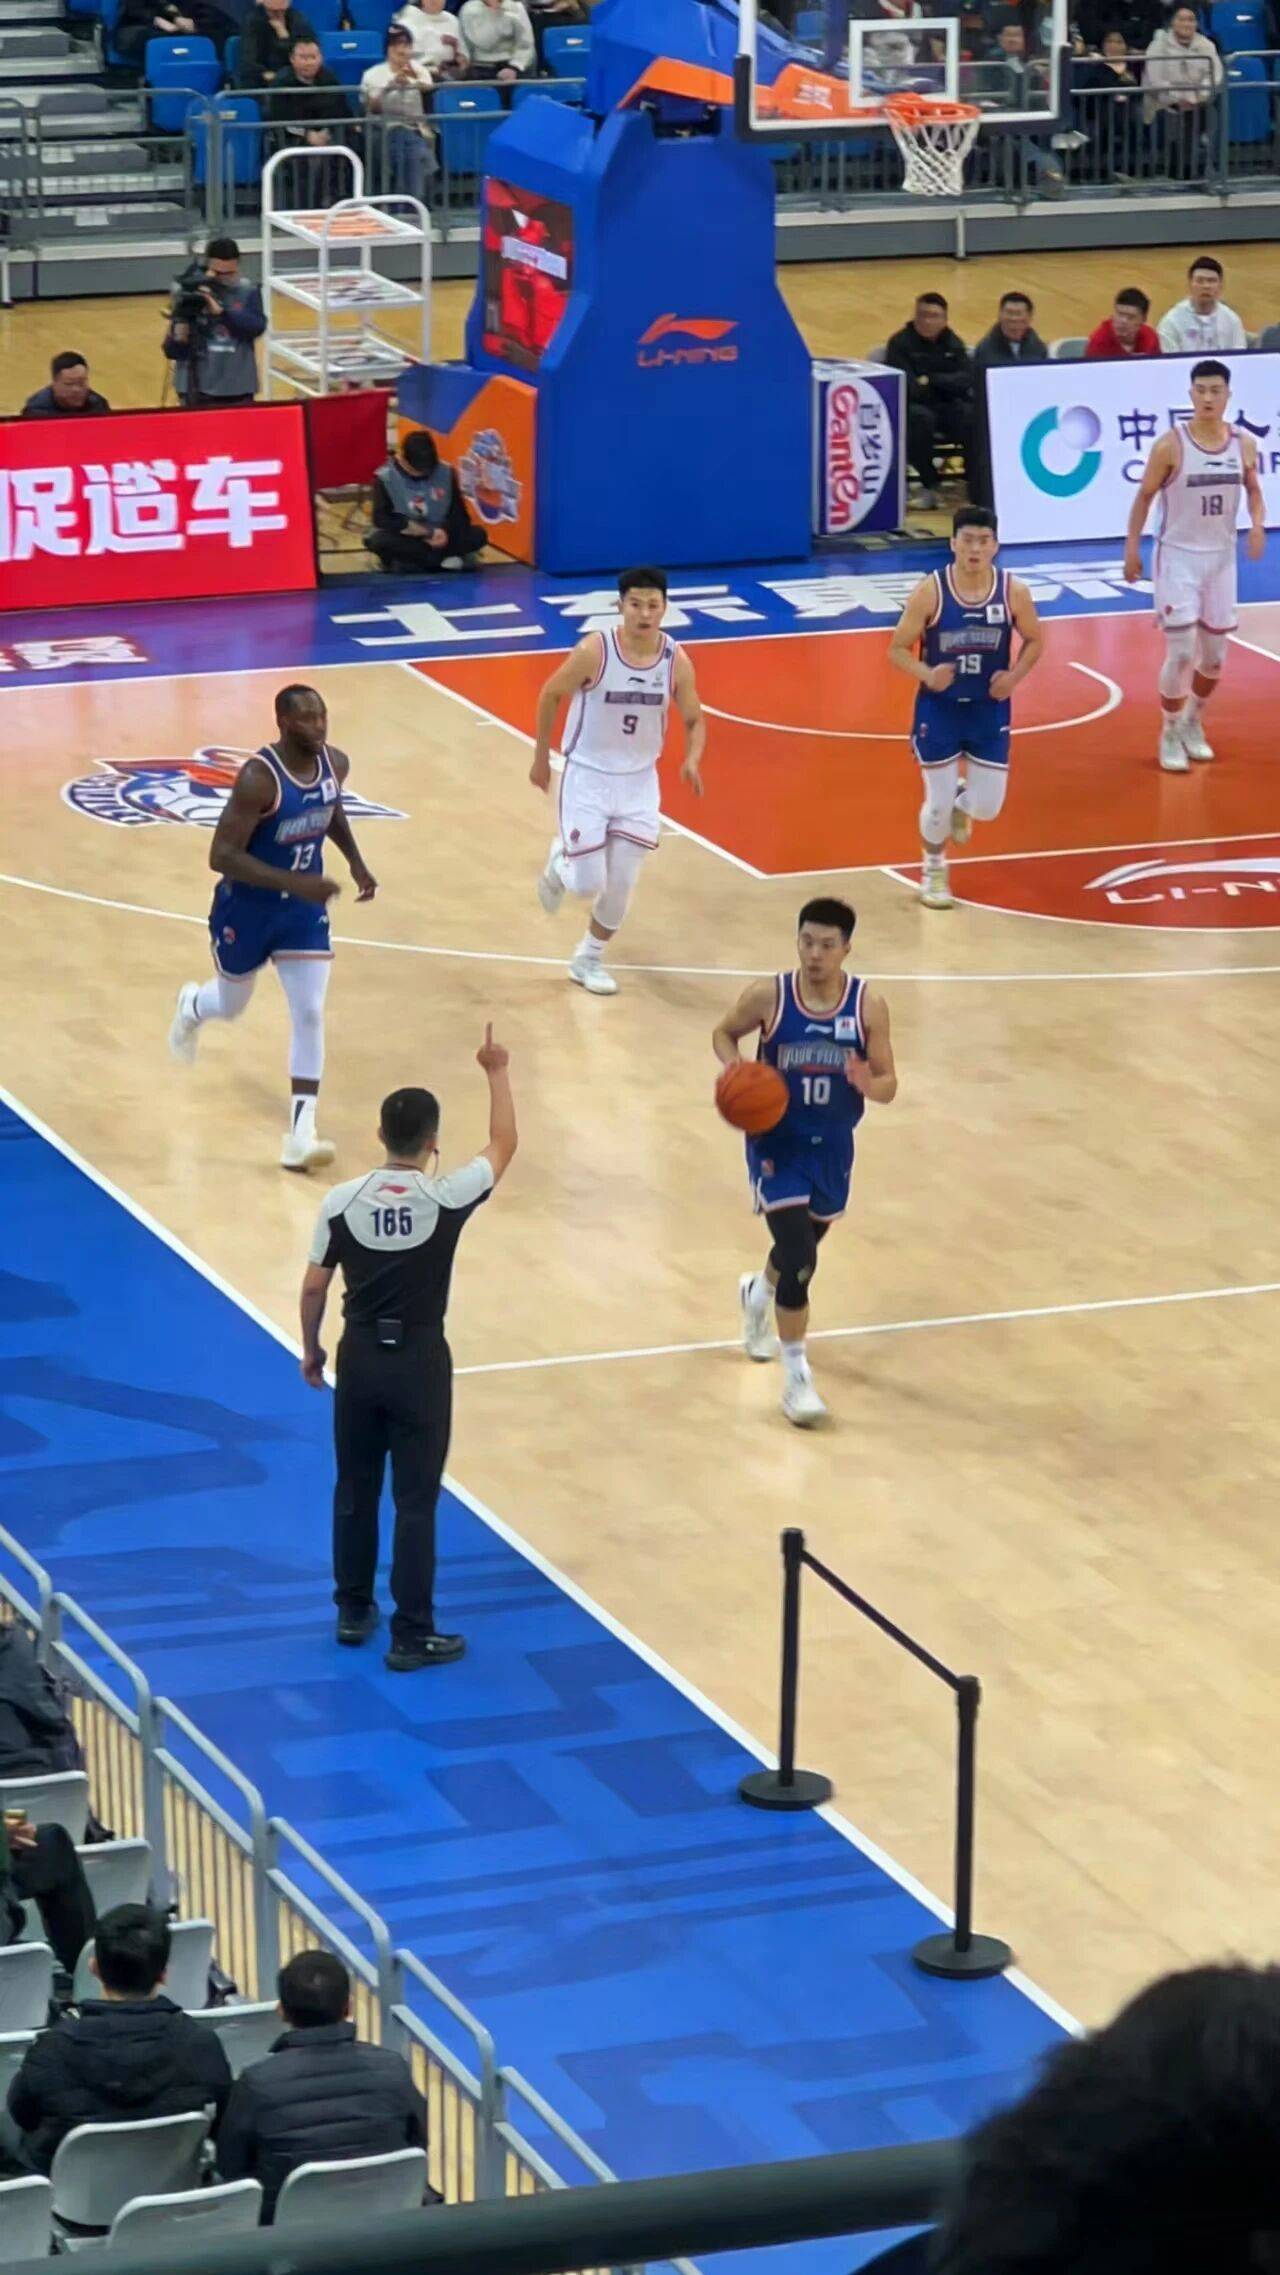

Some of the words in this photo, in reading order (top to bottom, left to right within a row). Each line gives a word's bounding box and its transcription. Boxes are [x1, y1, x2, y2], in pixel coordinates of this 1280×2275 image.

[956, 653, 982, 675] 19
[621, 713, 639, 735] 9
[290, 842, 316, 872] 13
[801, 1076, 831, 1106] 10
